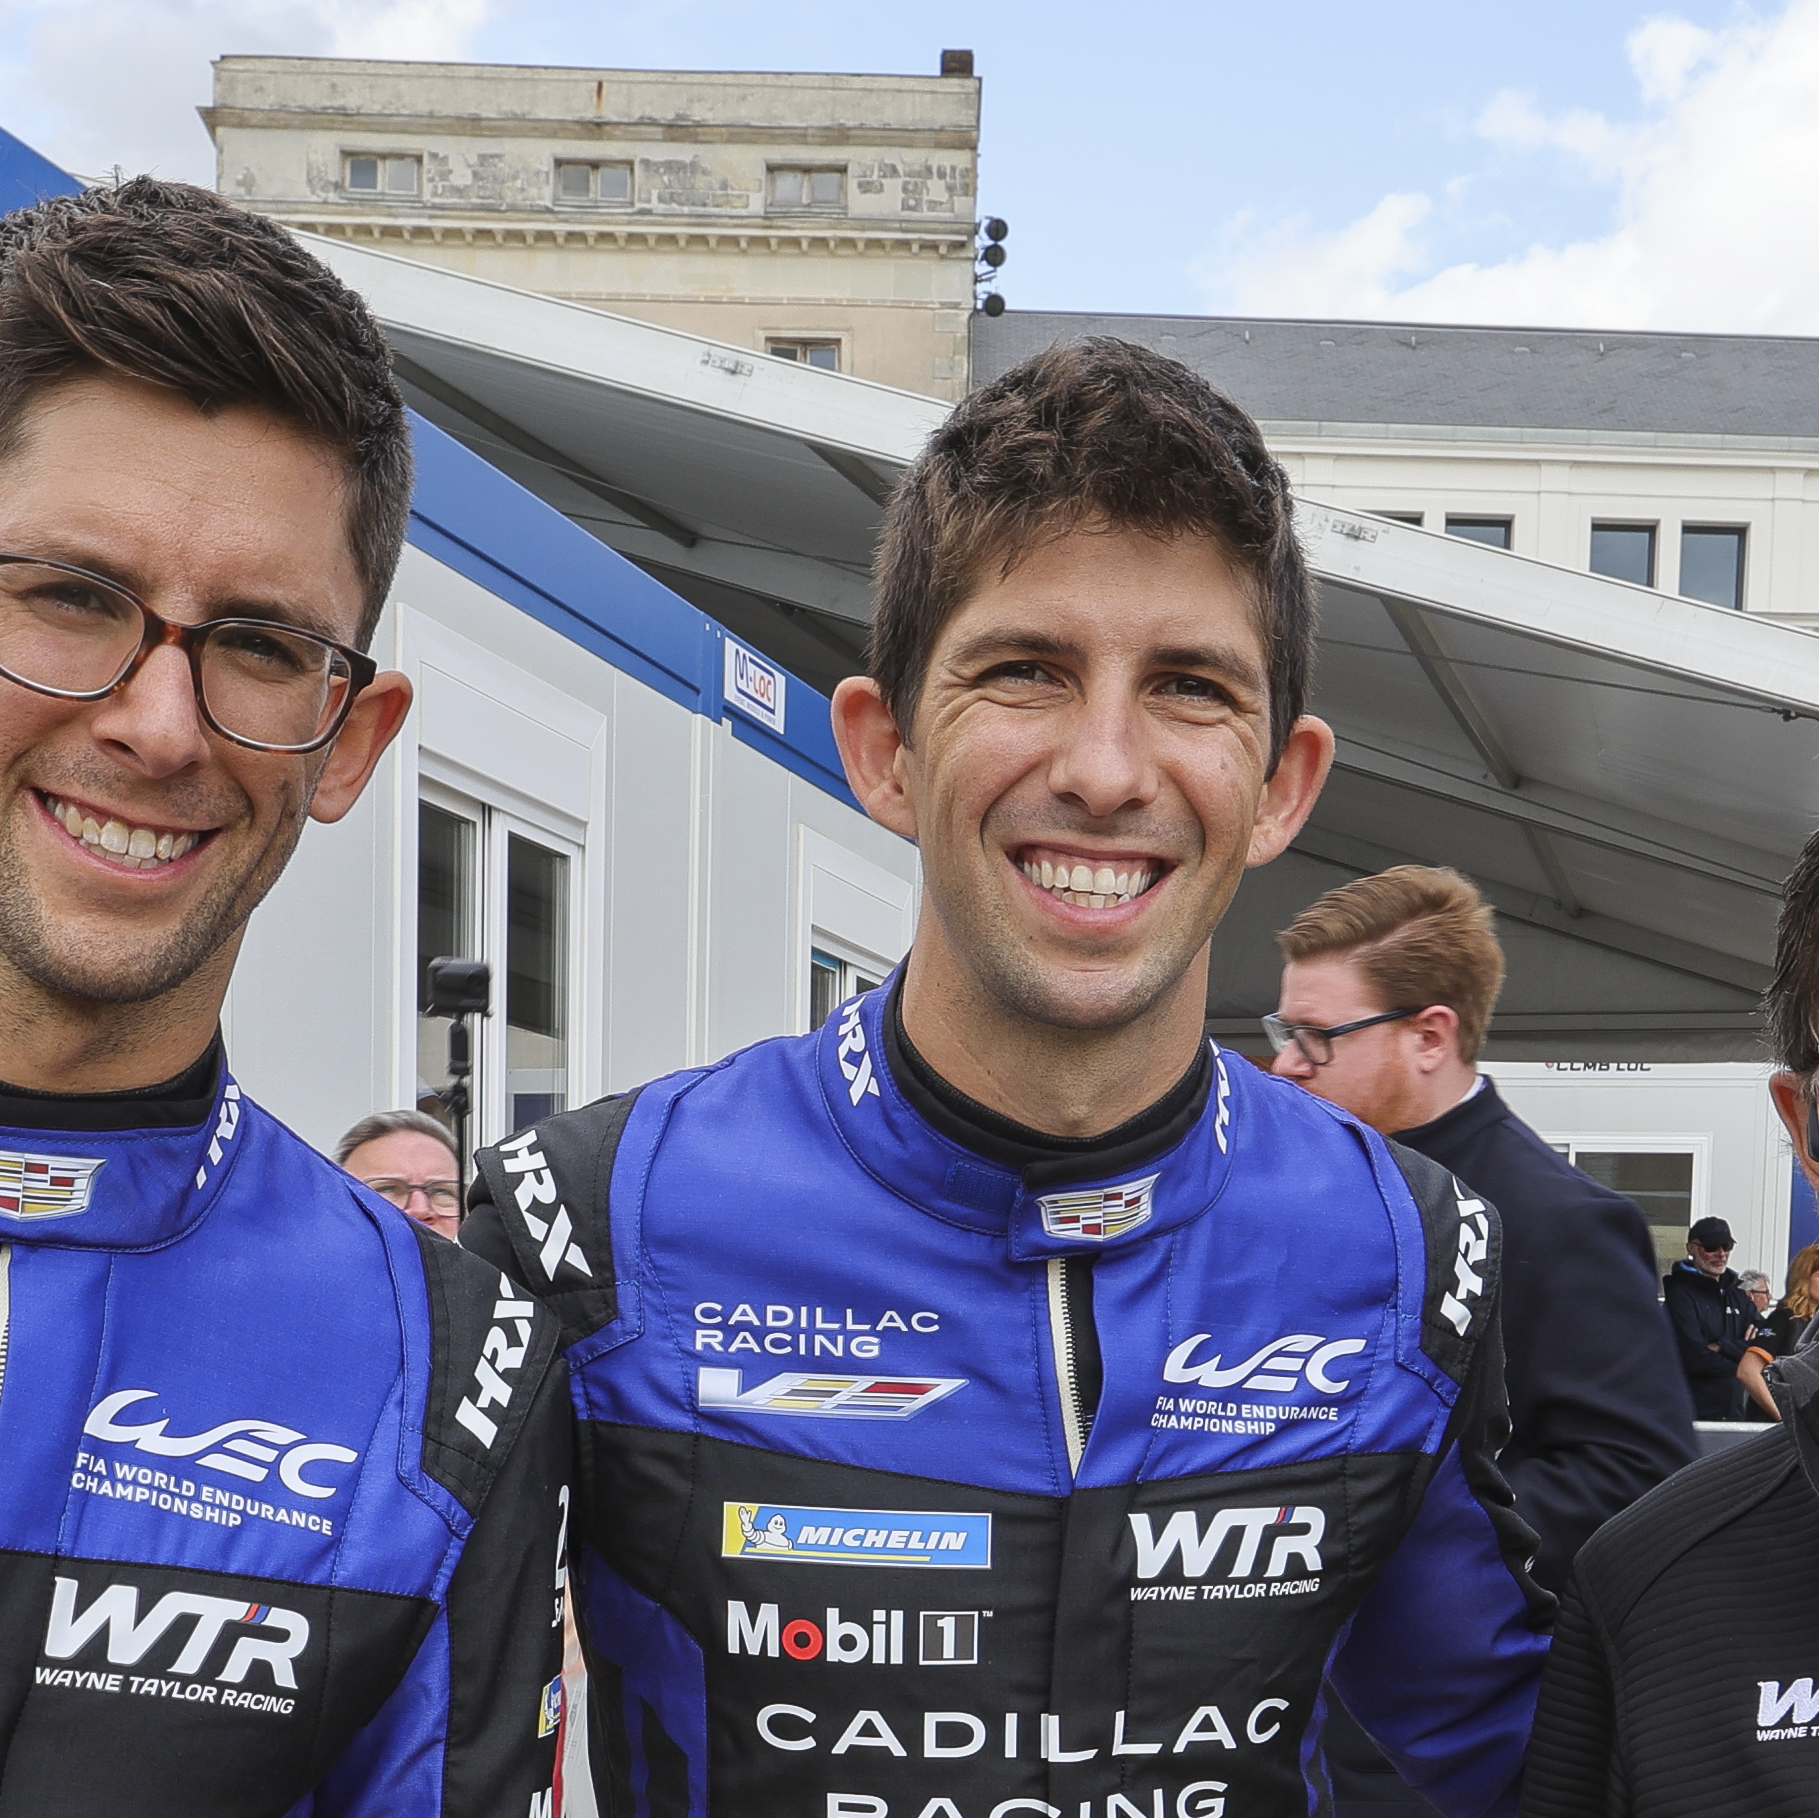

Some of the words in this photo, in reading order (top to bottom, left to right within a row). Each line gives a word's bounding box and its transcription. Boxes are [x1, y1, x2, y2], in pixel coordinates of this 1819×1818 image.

[493, 1127, 593, 1285] HRX
[694, 1302, 940, 1333] CADILLAC
[695, 1331, 881, 1358] RACING
[1163, 1333, 1367, 1394] WEC
[1150, 1412, 1276, 1435] CHAMPIONSHIP
[1154, 1396, 1174, 1413] FIA
[1178, 1398, 1237, 1418] WORLD
[1240, 1404, 1338, 1422] ENDURANCE
[83, 1389, 358, 1498] WEC
[71, 1473, 244, 1528] CHAMPIONSHIP
[75, 1452, 107, 1477] FIA
[113, 1463, 195, 1498] WORLD
[200, 1486, 333, 1536] ENDURANCE
[796, 1524, 969, 1552] MICHELIN
[1127, 1506, 1325, 1579] WTR
[1130, 1585, 1198, 1601] WAYNE
[1200, 1583, 1267, 1600] TAYLOR
[1267, 1574, 1321, 1597] RACING
[44, 1576, 311, 1690] WTR
[726, 1600, 904, 1666] Mobil
[35, 1666, 124, 1692] WAYNE
[129, 1676, 217, 1704] TAYLOR
[220, 1685, 297, 1714] RACING
[756, 1698, 1290, 1763] CADILLAC
[1756, 1724, 1808, 1742] WAYNE
